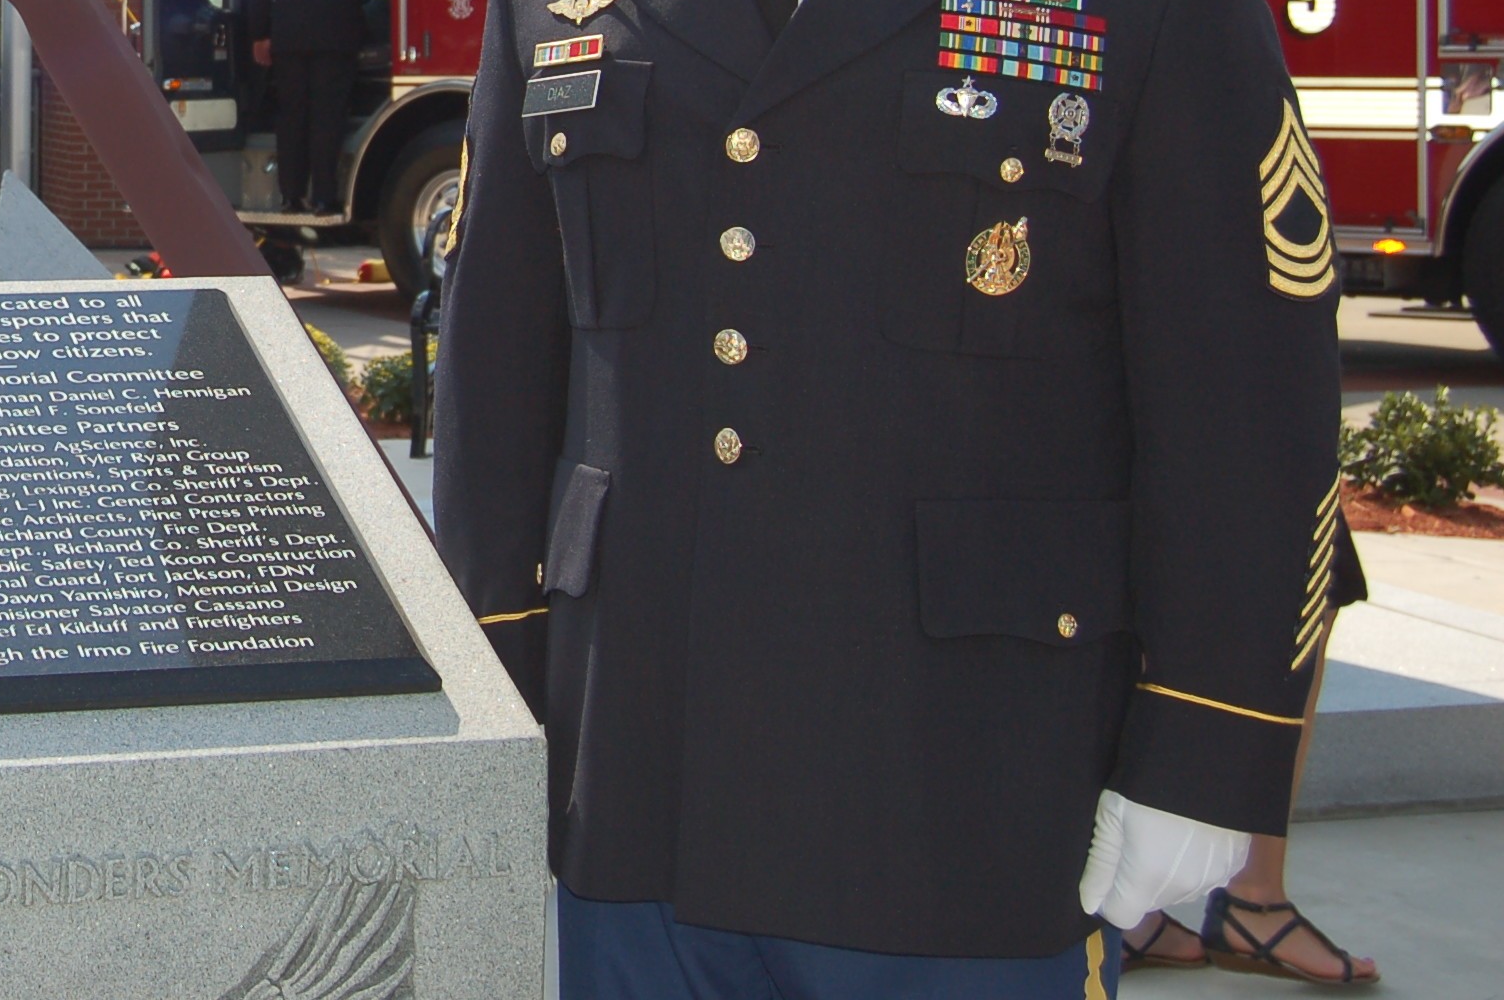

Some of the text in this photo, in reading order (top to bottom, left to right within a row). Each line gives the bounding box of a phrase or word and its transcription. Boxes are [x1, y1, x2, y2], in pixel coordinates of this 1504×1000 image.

[547, 84, 572, 101] DIAZ
[79, 298, 105, 308] to
[116, 295, 141, 307] all
[122, 311, 172, 323] that
[32, 331, 59, 342] to
[69, 328, 161, 344] protect
[66, 368, 204, 383] Committee
[48, 389, 115, 401] Daniel
[153, 386, 251, 400] Hennigan
[75, 401, 164, 414] Sonefeld
[76, 421, 179, 433] Partners
[79, 526, 155, 538] County
[163, 523, 199, 535] Fire
[113, 571, 156, 583] Fort
[257, 563, 315, 577] FDNY
[176, 580, 277, 596] Memorial
[283, 578, 357, 593] Design
[88, 603, 186, 616] Salvatore
[194, 599, 284, 612] Cassano
[25, 622, 52, 636] Ed
[59, 619, 127, 634] Kilduff
[138, 617, 179, 631] and
[185, 613, 302, 630] Firefighters
[31, 646, 68, 659] the
[77, 645, 131, 657] Irmo
[138, 641, 179, 654] Fire
[187, 635, 314, 652] Foundation
[214, 830, 512, 894] MEMORIAL
